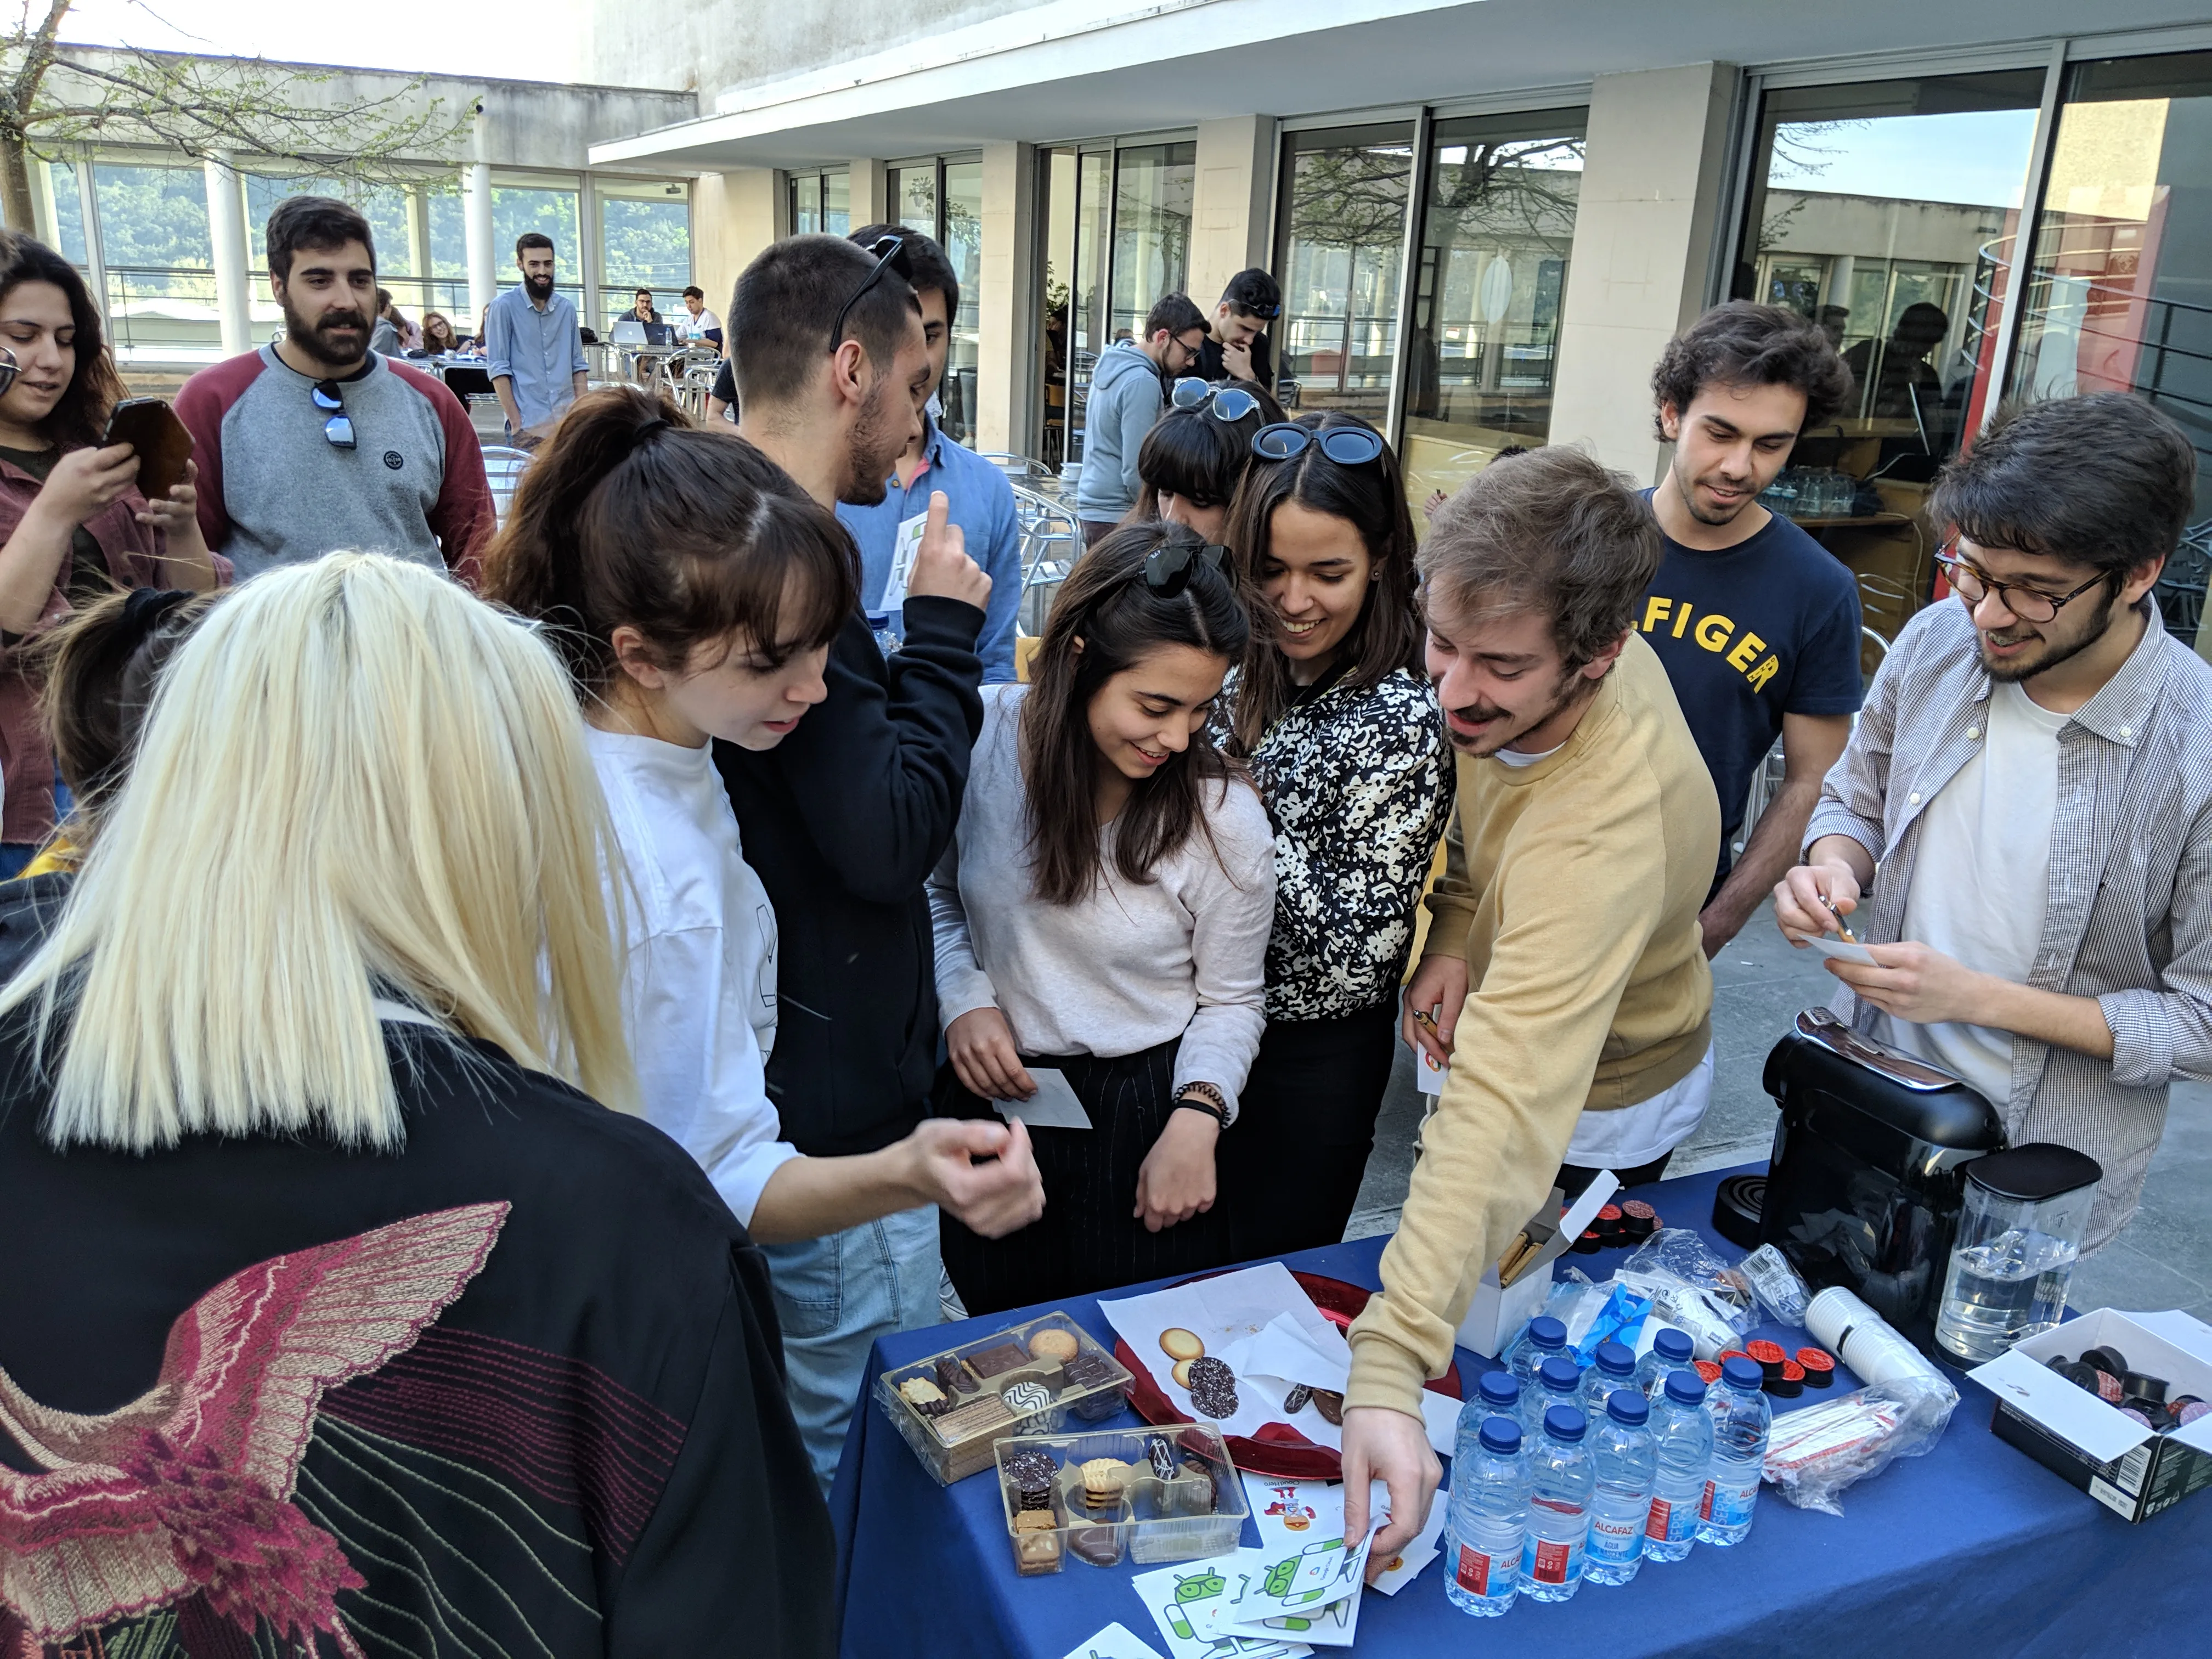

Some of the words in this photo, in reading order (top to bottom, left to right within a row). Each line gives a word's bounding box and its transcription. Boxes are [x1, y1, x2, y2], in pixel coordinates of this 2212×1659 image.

[1631, 596, 1779, 694] FIGER
[1748, 657, 1776, 681] DENIM
[1594, 1521, 1633, 1535] ALCAFAZ
